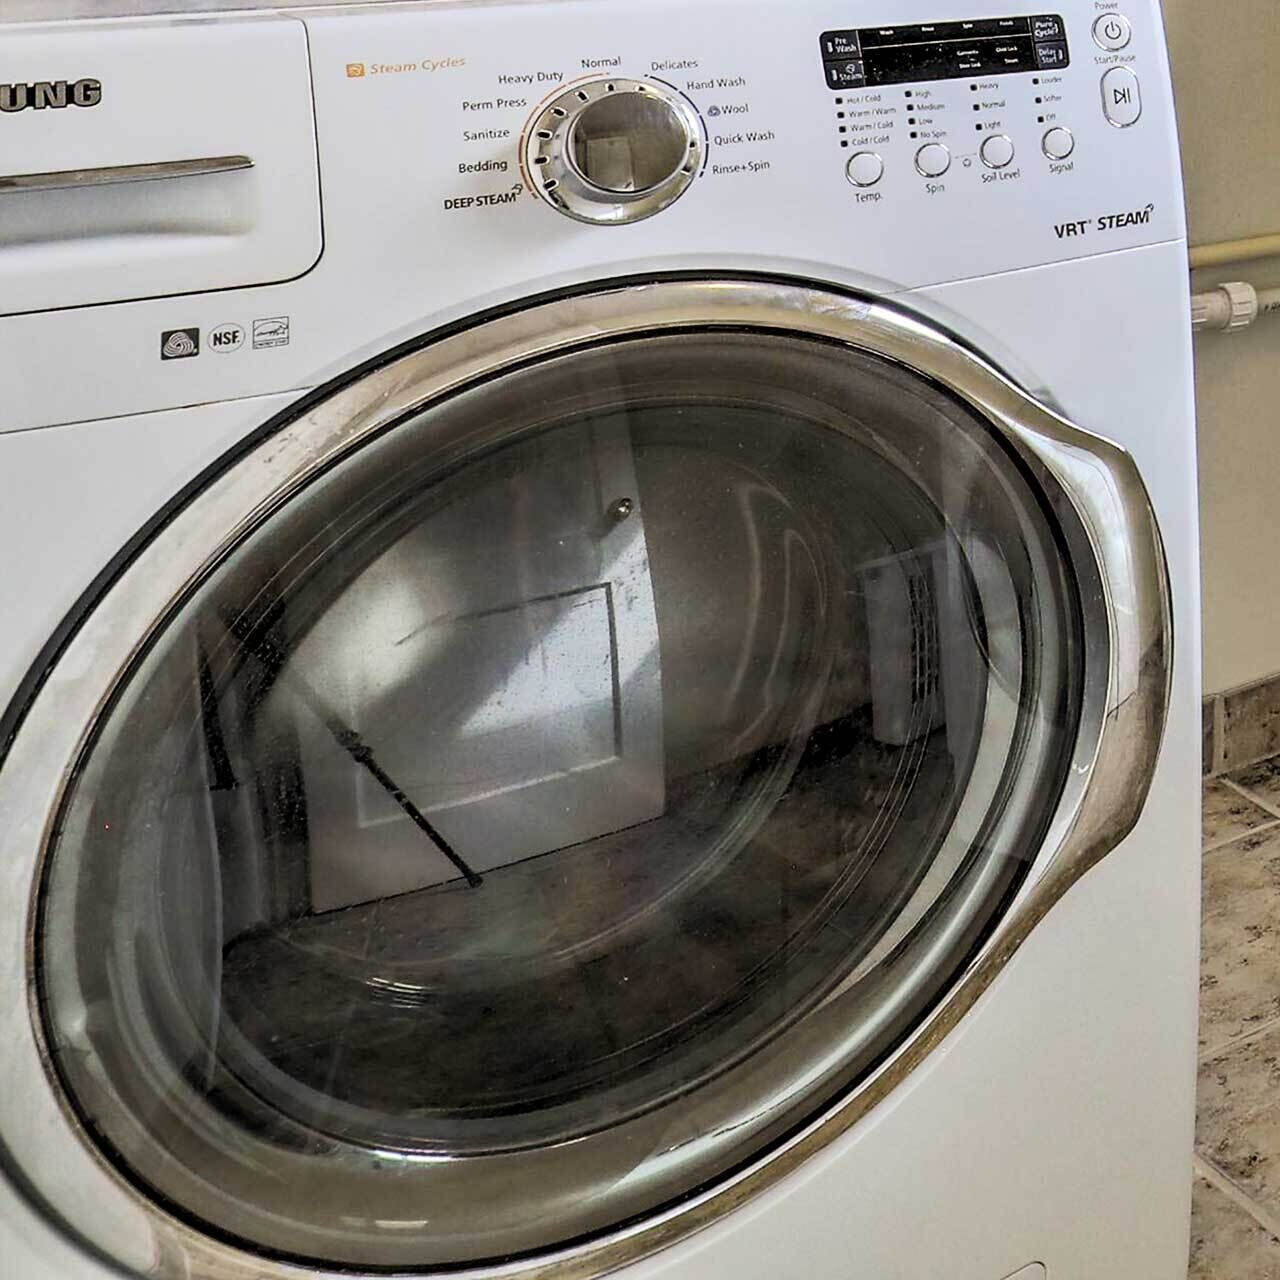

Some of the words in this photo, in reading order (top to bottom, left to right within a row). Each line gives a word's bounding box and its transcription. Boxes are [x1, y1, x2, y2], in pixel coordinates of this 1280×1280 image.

[1094, 1, 1119, 10] Power
[835, 37, 847, 45] Pre
[835, 45, 857, 54] Wash
[369, 61, 417, 75] Steam
[421, 56, 466, 72] Cycles
[581, 56, 622, 69] Normal
[651, 59, 699, 72] Delicates
[1041, 56, 1058, 64] Start
[1094, 54, 1136, 65] Start/Pause
[498, 72, 534, 85] Heavy
[537, 71, 564, 83] Duty
[686, 78, 714, 90] Hand
[716, 76, 746, 88] Wash
[839, 73, 863, 81] Steam
[462, 101, 493, 112] Perm
[496, 97, 528, 109] Press
[721, 103, 749, 115] Wool
[916, 103, 945, 111] Medium
[981, 100, 1006, 109] Normal
[848, 110, 870, 119] Warm
[876, 107, 897, 115] Warm
[851, 124, 872, 132] Warm
[877, 121, 894, 129] Cold
[463, 128, 511, 142] Sanitize
[714, 133, 744, 147] Quick
[746, 131, 775, 143] Wash
[852, 138, 868, 147] Cold
[873, 135, 890, 144] Cold
[931, 130, 947, 140] Spin
[458, 159, 508, 175] Bedding
[712, 159, 771, 176] Rinse+Spin
[1049, 161, 1074, 175] Signal
[981, 172, 997, 184] Soil
[999, 169, 1021, 181] Level
[925, 183, 945, 195] Spin
[444, 197, 475, 210] DEEP
[475, 192, 516, 207] STEAM
[1096, 210, 1150, 231] STEAM
